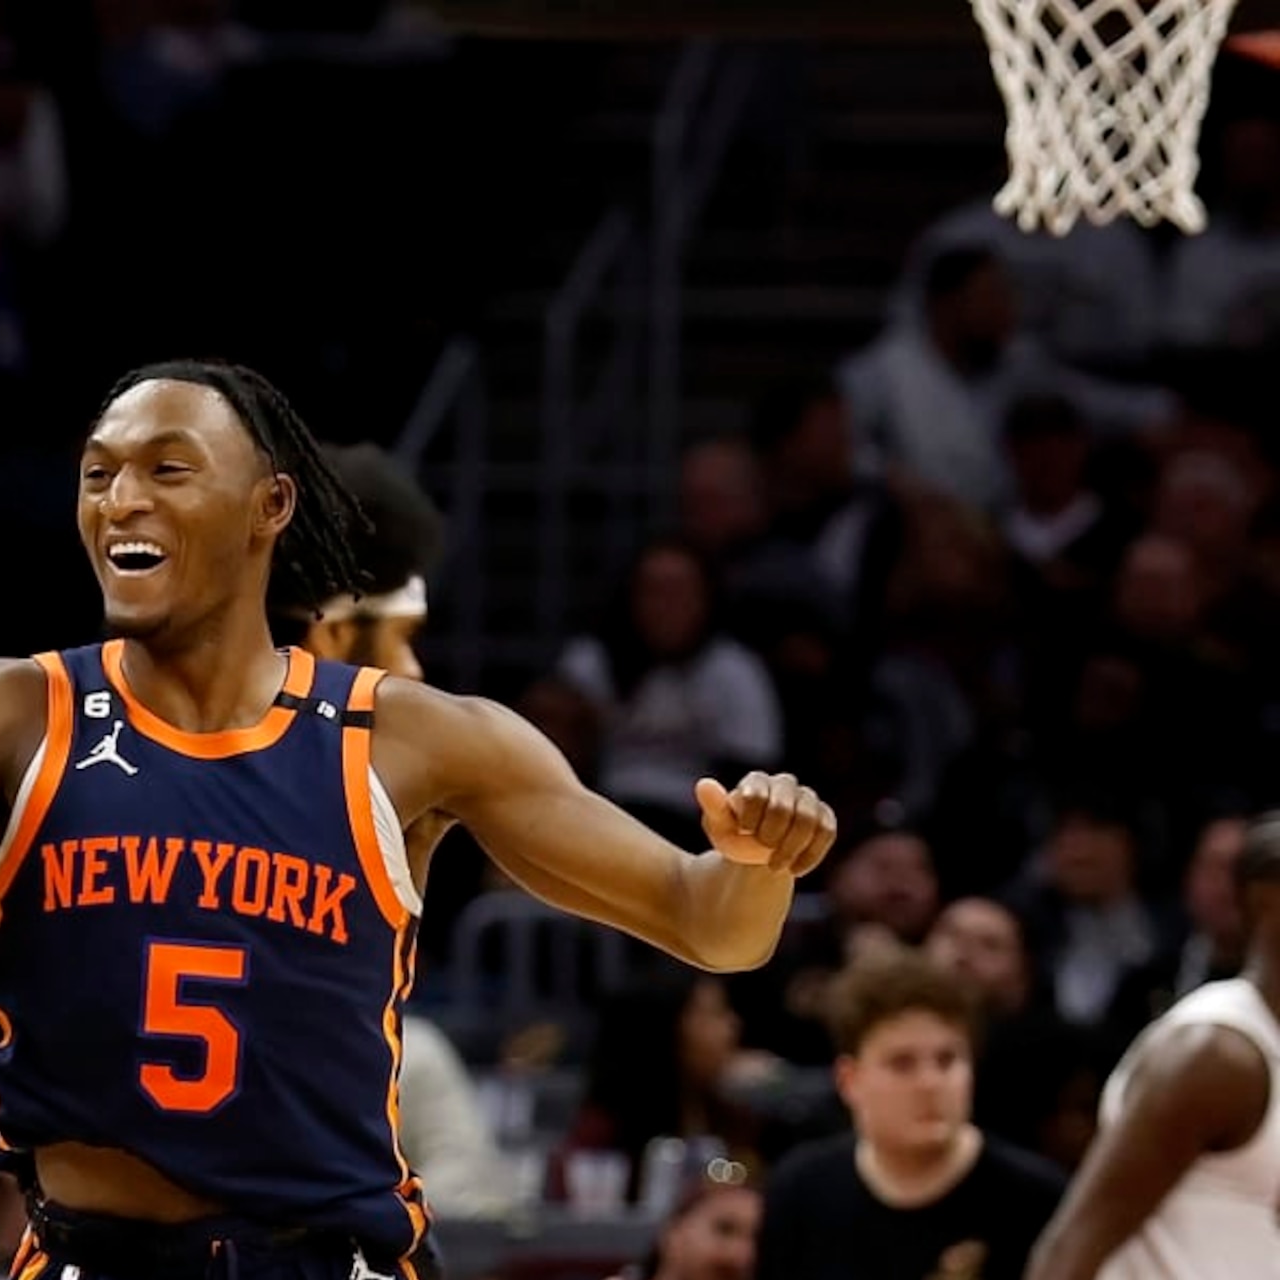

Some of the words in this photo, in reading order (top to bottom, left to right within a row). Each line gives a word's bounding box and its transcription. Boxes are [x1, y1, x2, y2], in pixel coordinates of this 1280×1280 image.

[83, 691, 112, 719] 6
[41, 835, 185, 912] NEW
[191, 839, 357, 945] YORK
[139, 941, 246, 1112] 5
